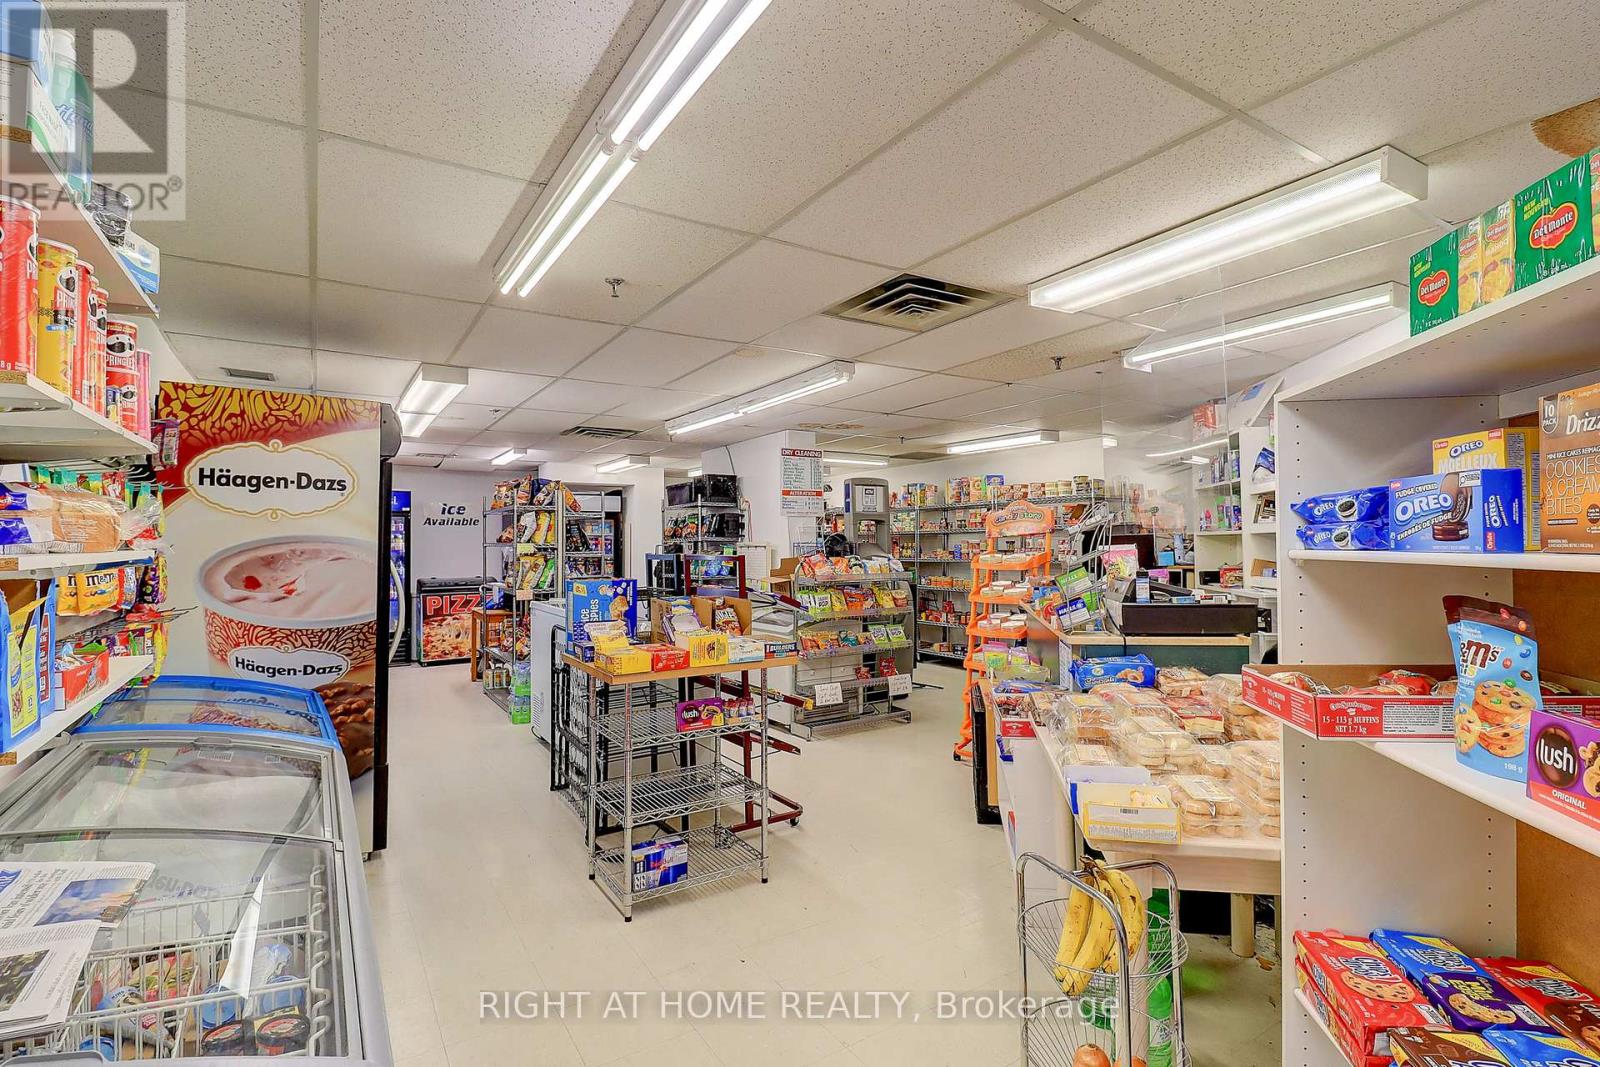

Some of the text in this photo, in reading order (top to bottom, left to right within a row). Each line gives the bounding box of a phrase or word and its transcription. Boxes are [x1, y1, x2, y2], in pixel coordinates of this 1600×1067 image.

[1534, 212, 1573, 239] Del Monte
[1430, 278, 1446, 290] Monte
[1544, 404, 1555, 418] 10
[794, 450, 821, 458] CLEANING
[1450, 440, 1483, 457] OREO
[198, 466, 347, 493] Häagen-Dazs
[1396, 488, 1415, 499] FUDGE
[1546, 480, 1553, 497] &
[441, 503, 466, 515] ice
[1314, 502, 1335, 516] OREO
[1395, 493, 1452, 522] OREO
[1489, 495, 1502, 528] OREO
[1546, 496, 1582, 515] BITES
[424, 517, 480, 526] Available
[1422, 519, 1431, 529] DE
[1431, 512, 1452, 525] FUDGE
[1314, 532, 1331, 544] OREO
[426, 594, 490, 616] PIZZ
[235, 656, 343, 678] Häagen-Dazs
[1360, 726, 1367, 734] kg
[1540, 738, 1574, 774] lush
[1552, 789, 1587, 810] ORIGINAL
